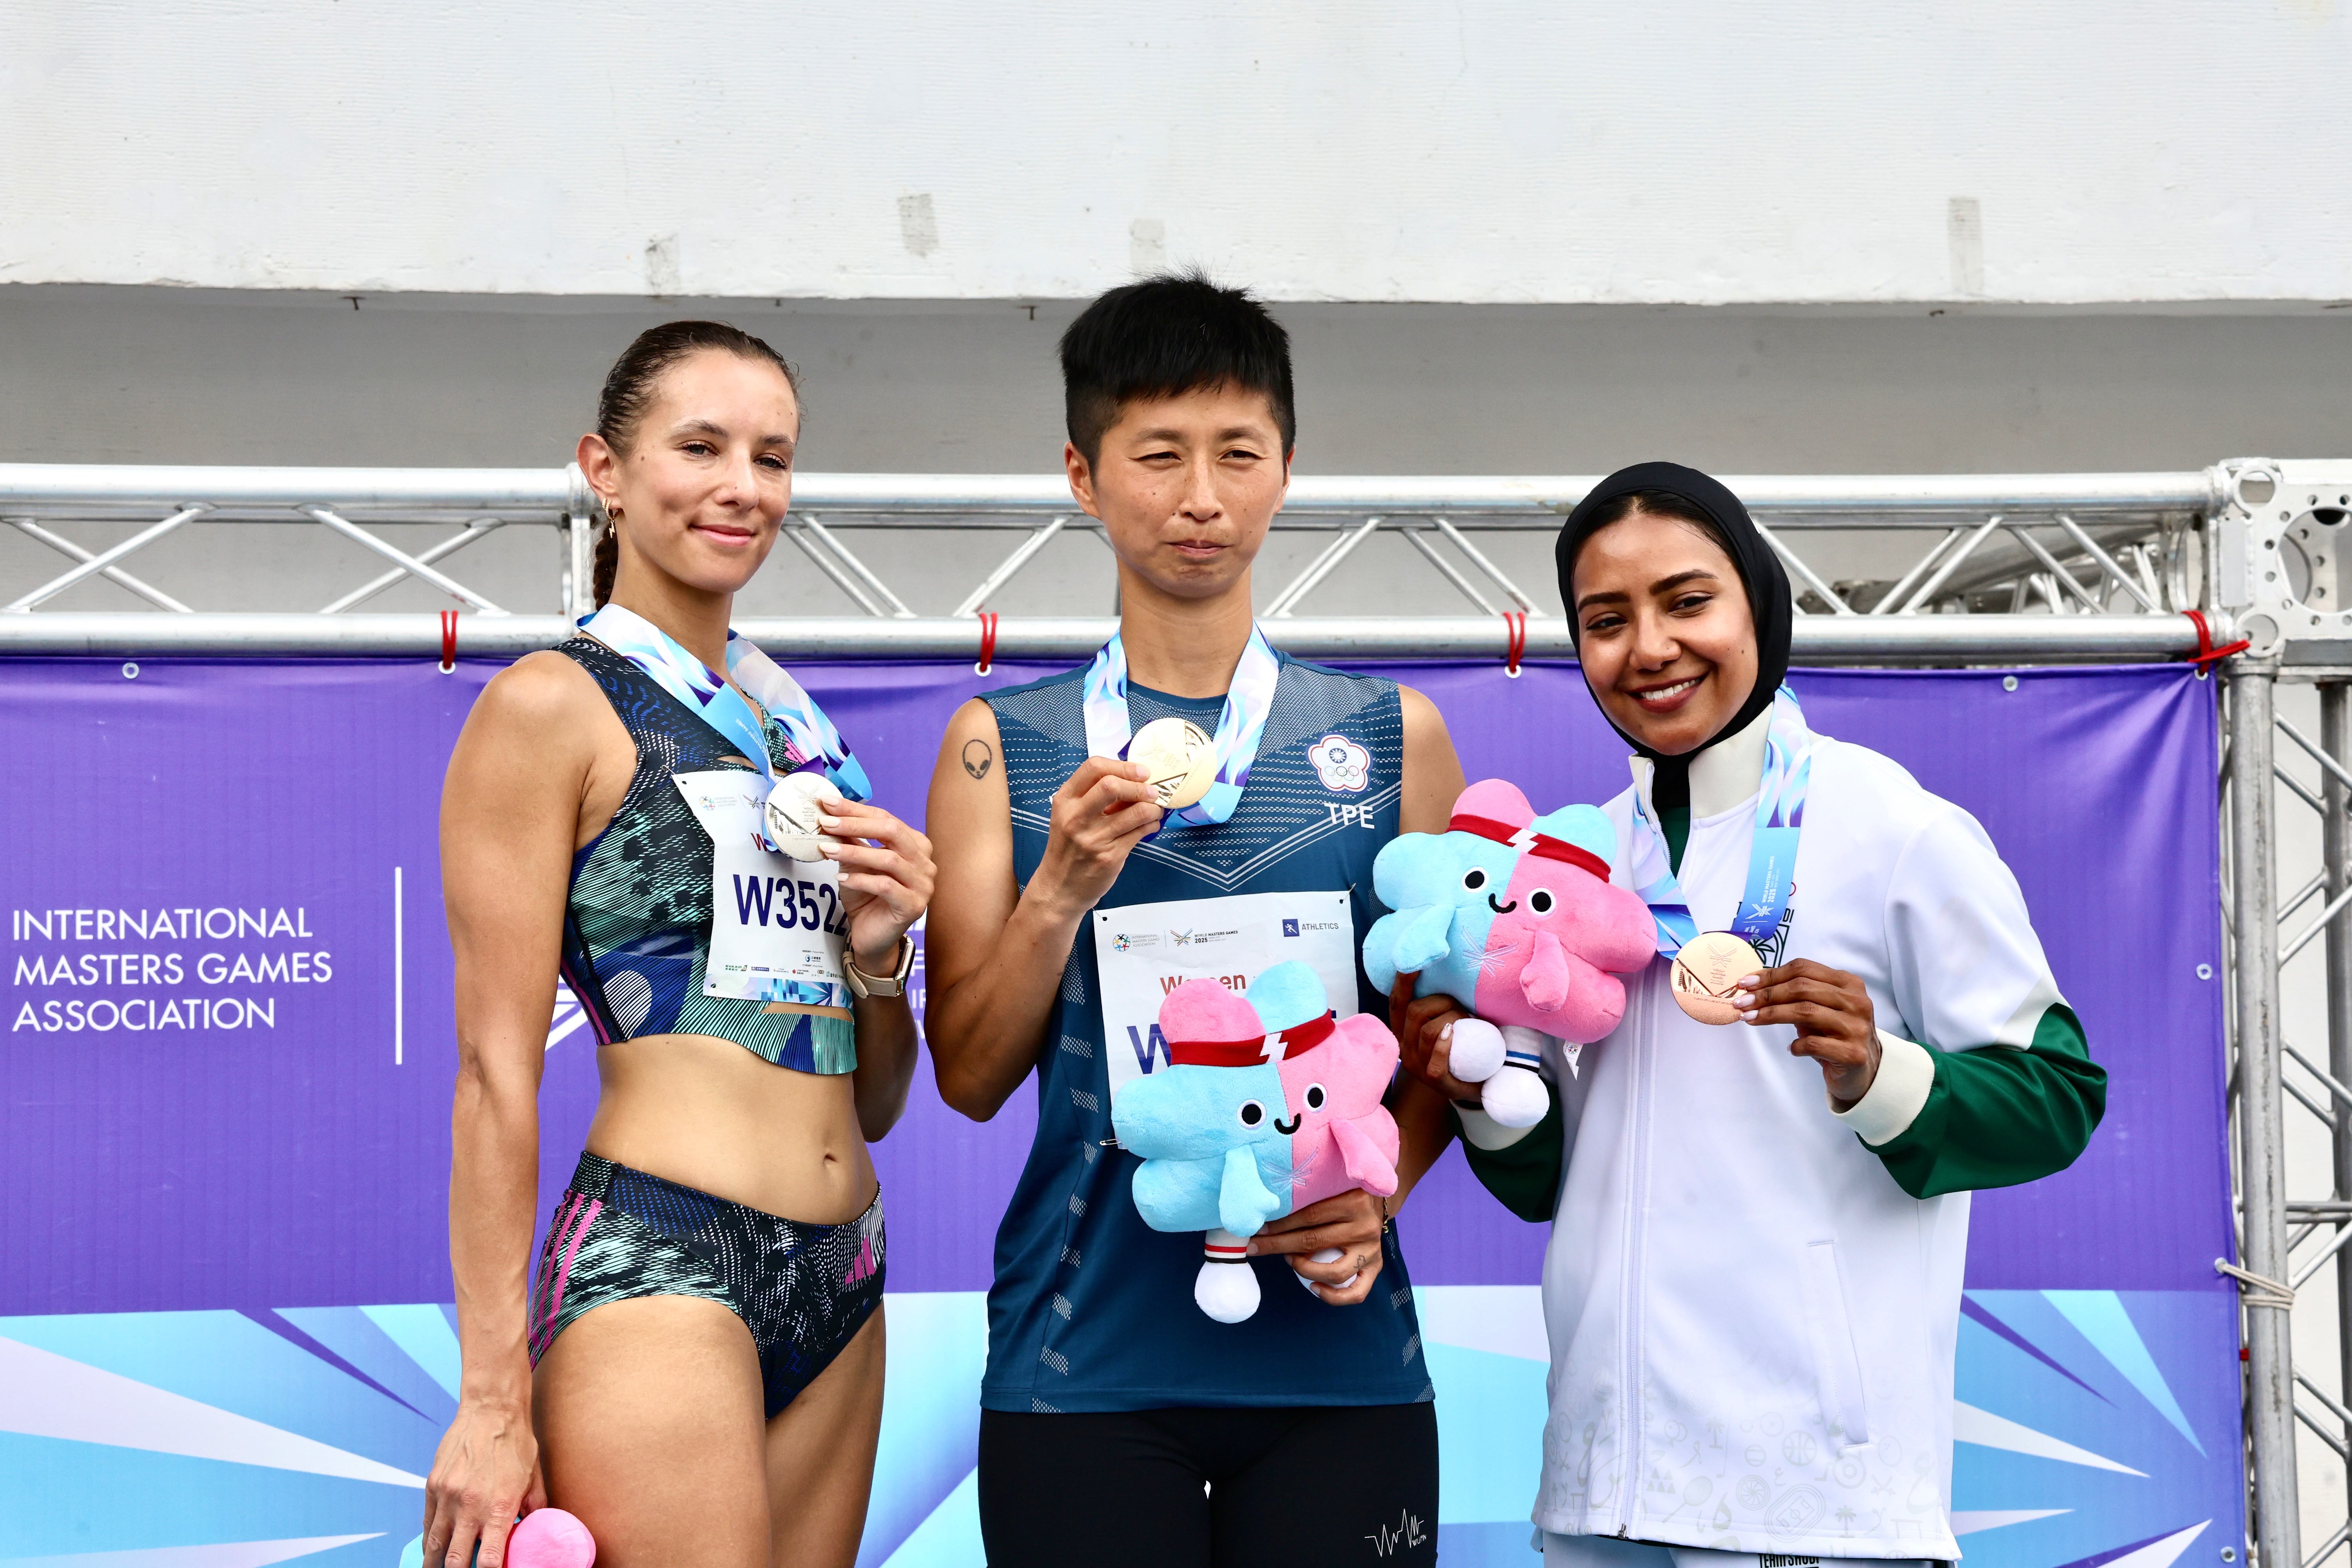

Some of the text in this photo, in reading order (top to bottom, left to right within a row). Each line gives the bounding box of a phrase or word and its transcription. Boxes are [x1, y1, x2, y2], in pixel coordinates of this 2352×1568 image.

[1325, 803, 1375, 829] TPE
[1767, 888, 1777, 903] 2025
[13, 907, 313, 940] INTERNATIONAL
[14, 951, 332, 985] MASTERS GAMES
[1160, 975, 1246, 996] Wen
[12, 998, 275, 1032] ASSOCIATION
